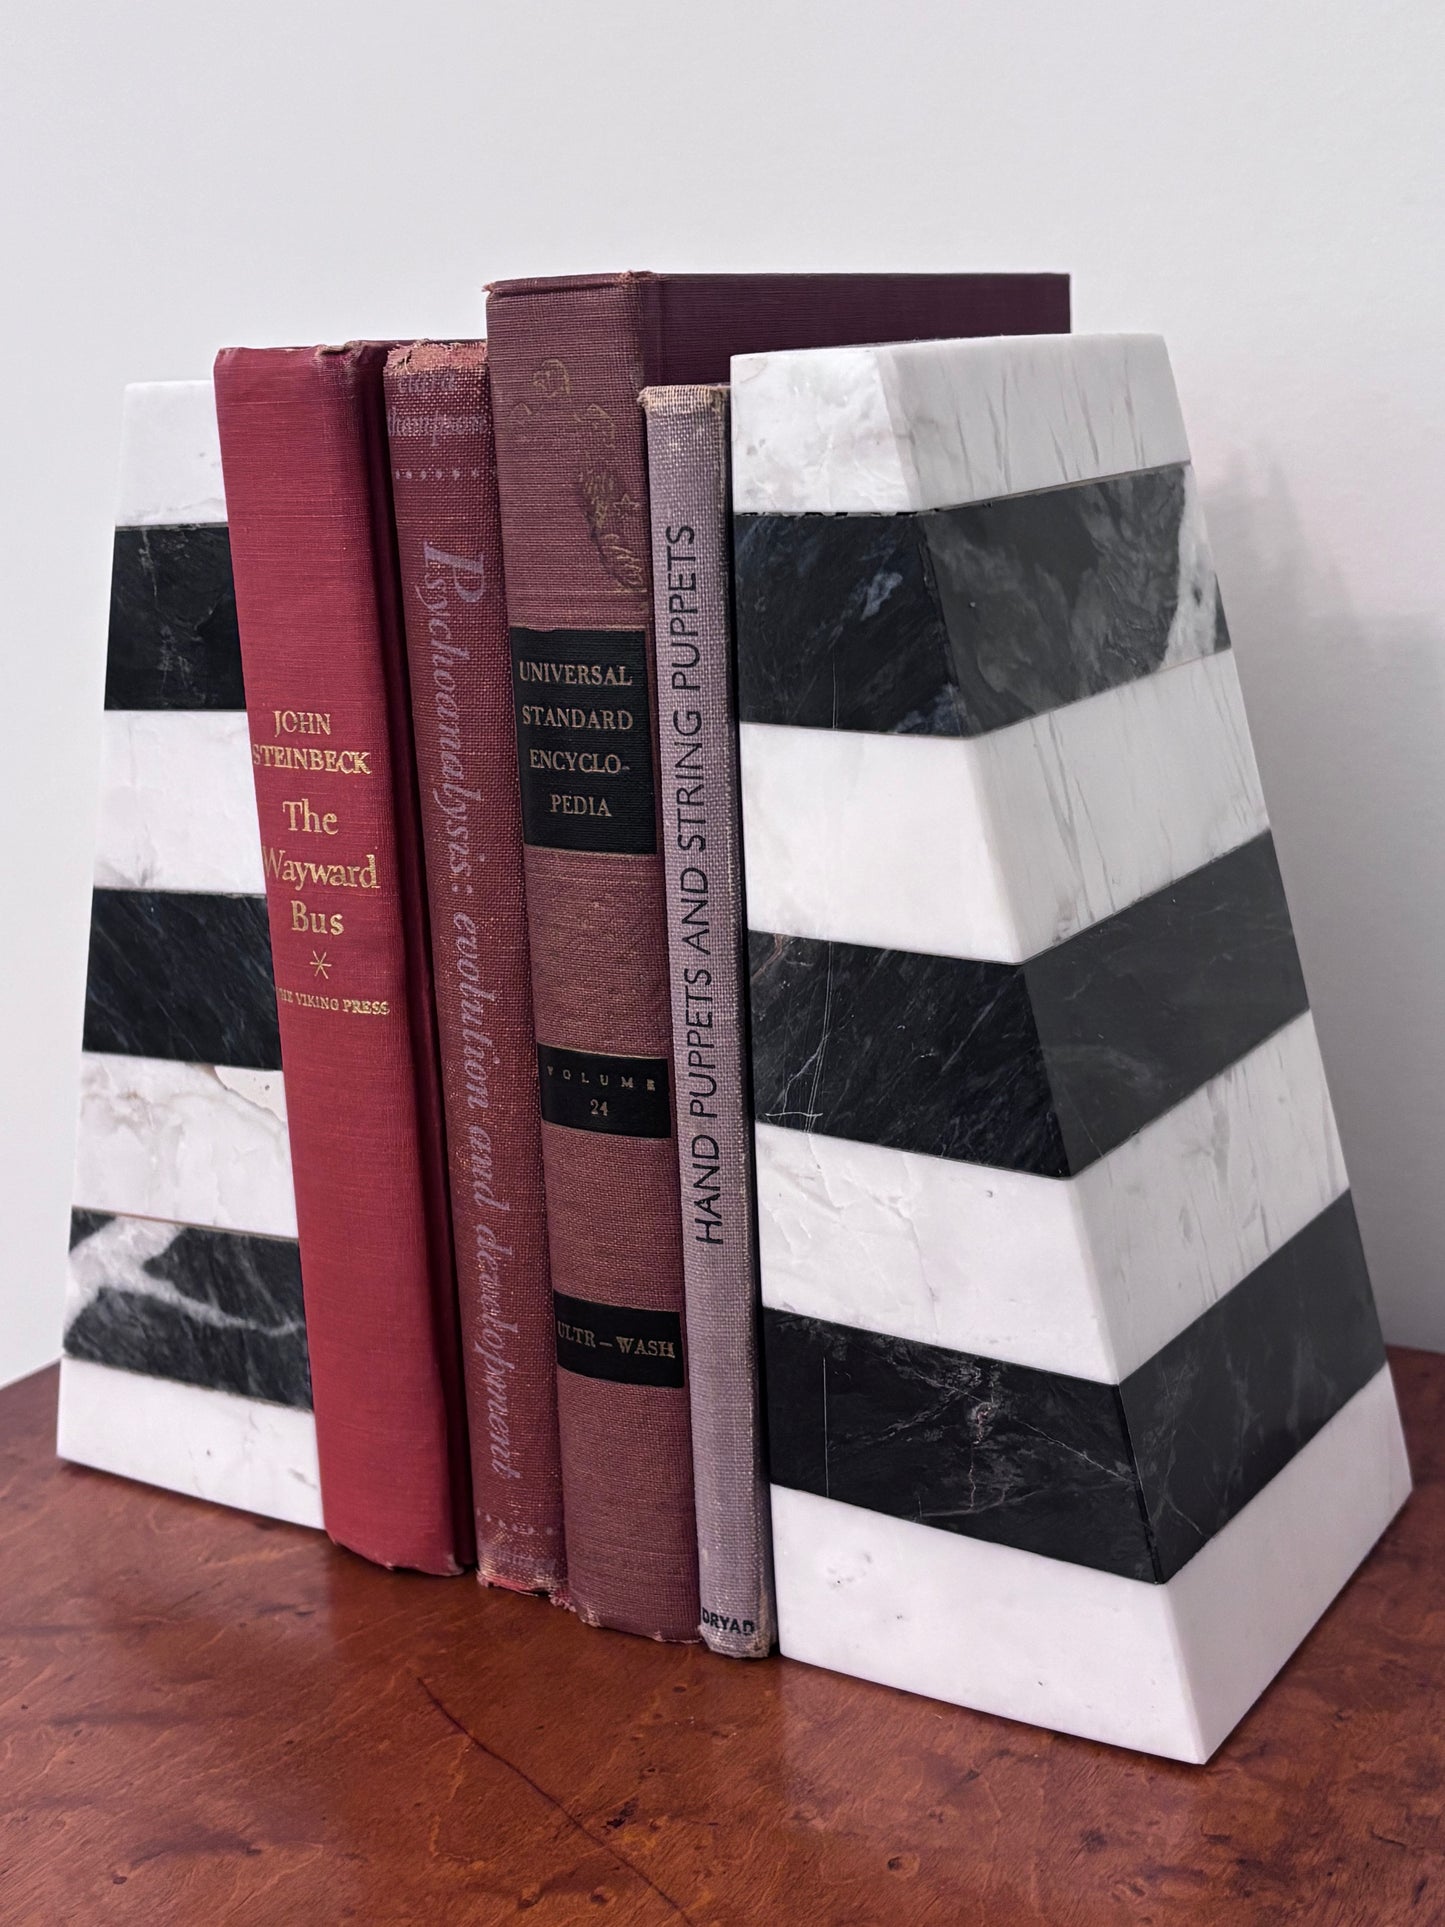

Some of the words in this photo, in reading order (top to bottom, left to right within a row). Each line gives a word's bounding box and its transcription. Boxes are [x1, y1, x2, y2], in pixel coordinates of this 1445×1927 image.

[666, 526, 701, 691] PUPPETS
[519, 661, 633, 686] UNIVERSAL
[272, 710, 331, 737] JOHN
[415, 540, 485, 894] Psychoanalysis:
[521, 704, 633, 730] STANDARD
[252, 744, 372, 774] STEINBECK
[529, 749, 631, 774] ENCYCLO-
[672, 710, 707, 851] STRING
[282, 798, 339, 835] The
[550, 794, 612, 817] PEDIA
[262, 846, 381, 891] Wayward
[290, 900, 345, 936] Bus
[680, 867, 712, 956] AND
[295, 992, 339, 1011] VIKING
[342, 999, 390, 1015] PRESS
[453, 912, 500, 1109] evolution
[684, 967, 718, 1119] PUPPETS
[547, 1065, 656, 1092] VOLUME
[590, 1099, 608, 1116] 24
[469, 1125, 510, 1211] and
[691, 1133, 723, 1245] HAND
[475, 1224, 521, 1478] development
[702, 1607, 755, 1636] DRYAD
